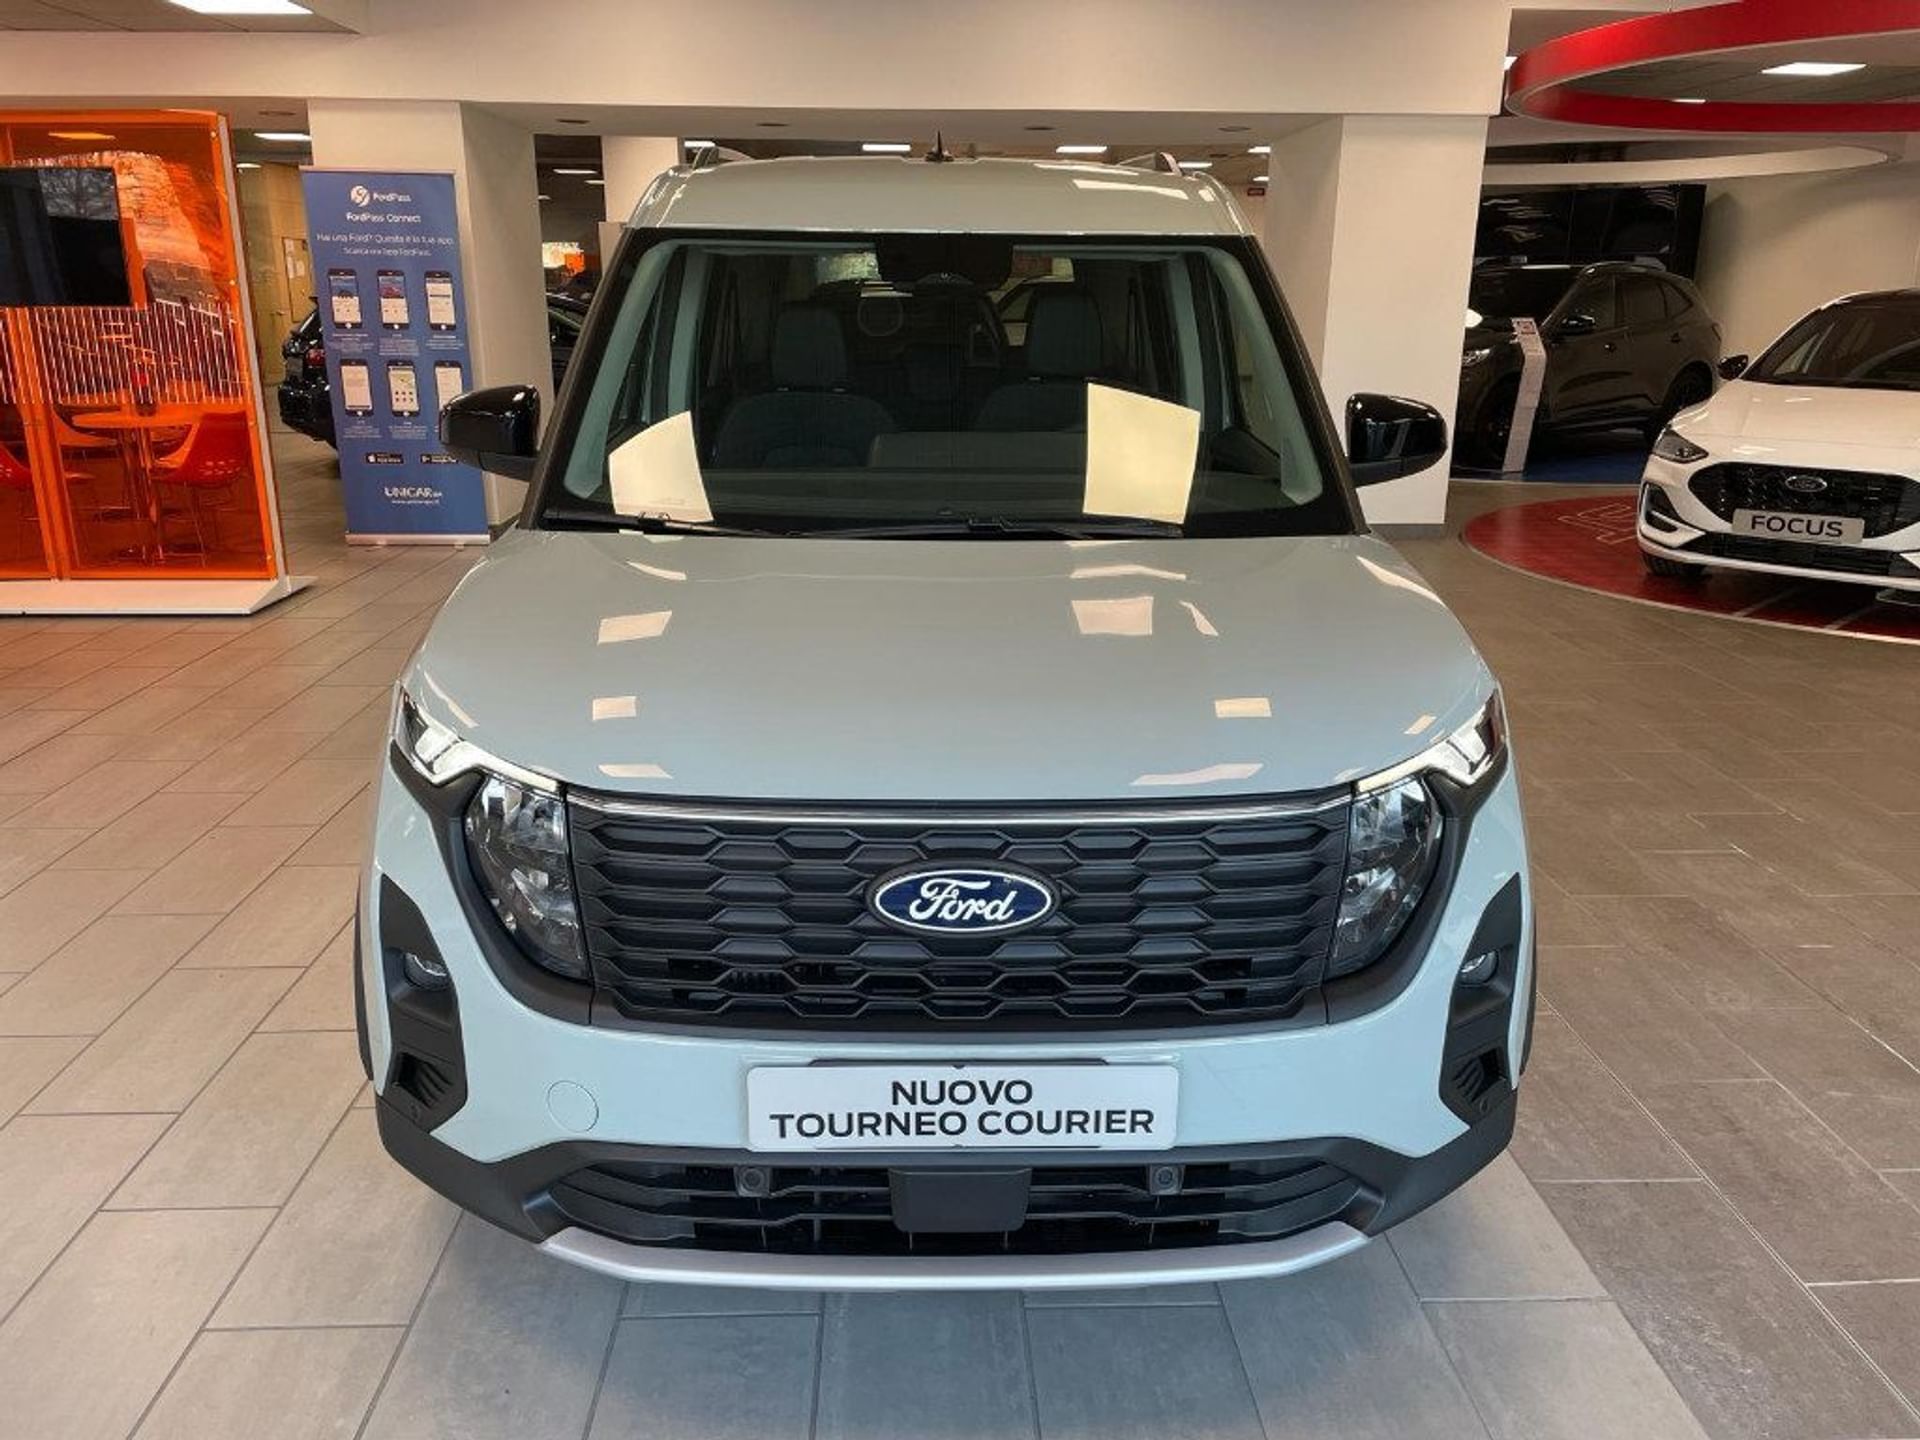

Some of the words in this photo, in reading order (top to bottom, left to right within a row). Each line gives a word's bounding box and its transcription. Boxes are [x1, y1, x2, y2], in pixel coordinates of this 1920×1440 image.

[386, 213, 421, 223] Connect
[384, 487, 433, 498] UNICAR
[1751, 515, 1843, 537] FOCUS
[909, 878, 1018, 921] Ford
[891, 1080, 1034, 1106] NUOVO
[769, 1111, 967, 1139] TOURNEO
[978, 1110, 1155, 1135] COURIER
